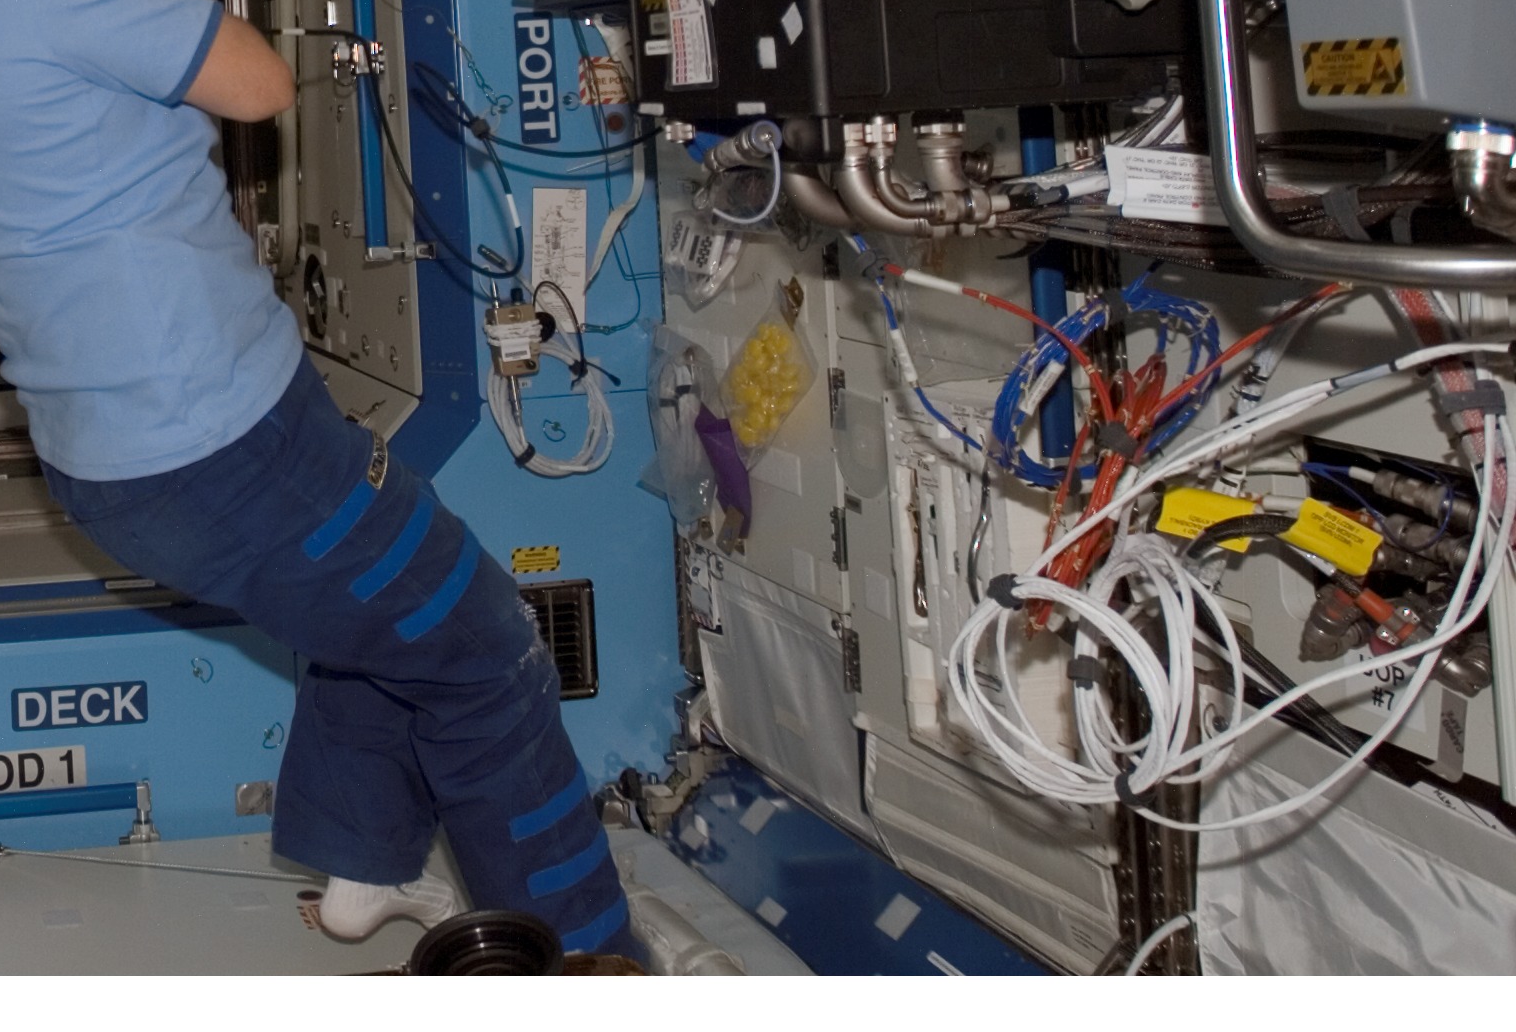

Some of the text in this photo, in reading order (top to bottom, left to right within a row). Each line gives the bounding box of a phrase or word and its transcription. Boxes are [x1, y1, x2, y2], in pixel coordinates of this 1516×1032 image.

[517, 18, 557, 139] PORT
[16, 684, 145, 728] DECK
[1371, 686, 1395, 711] #7
[59, 749, 75, 786] 1
